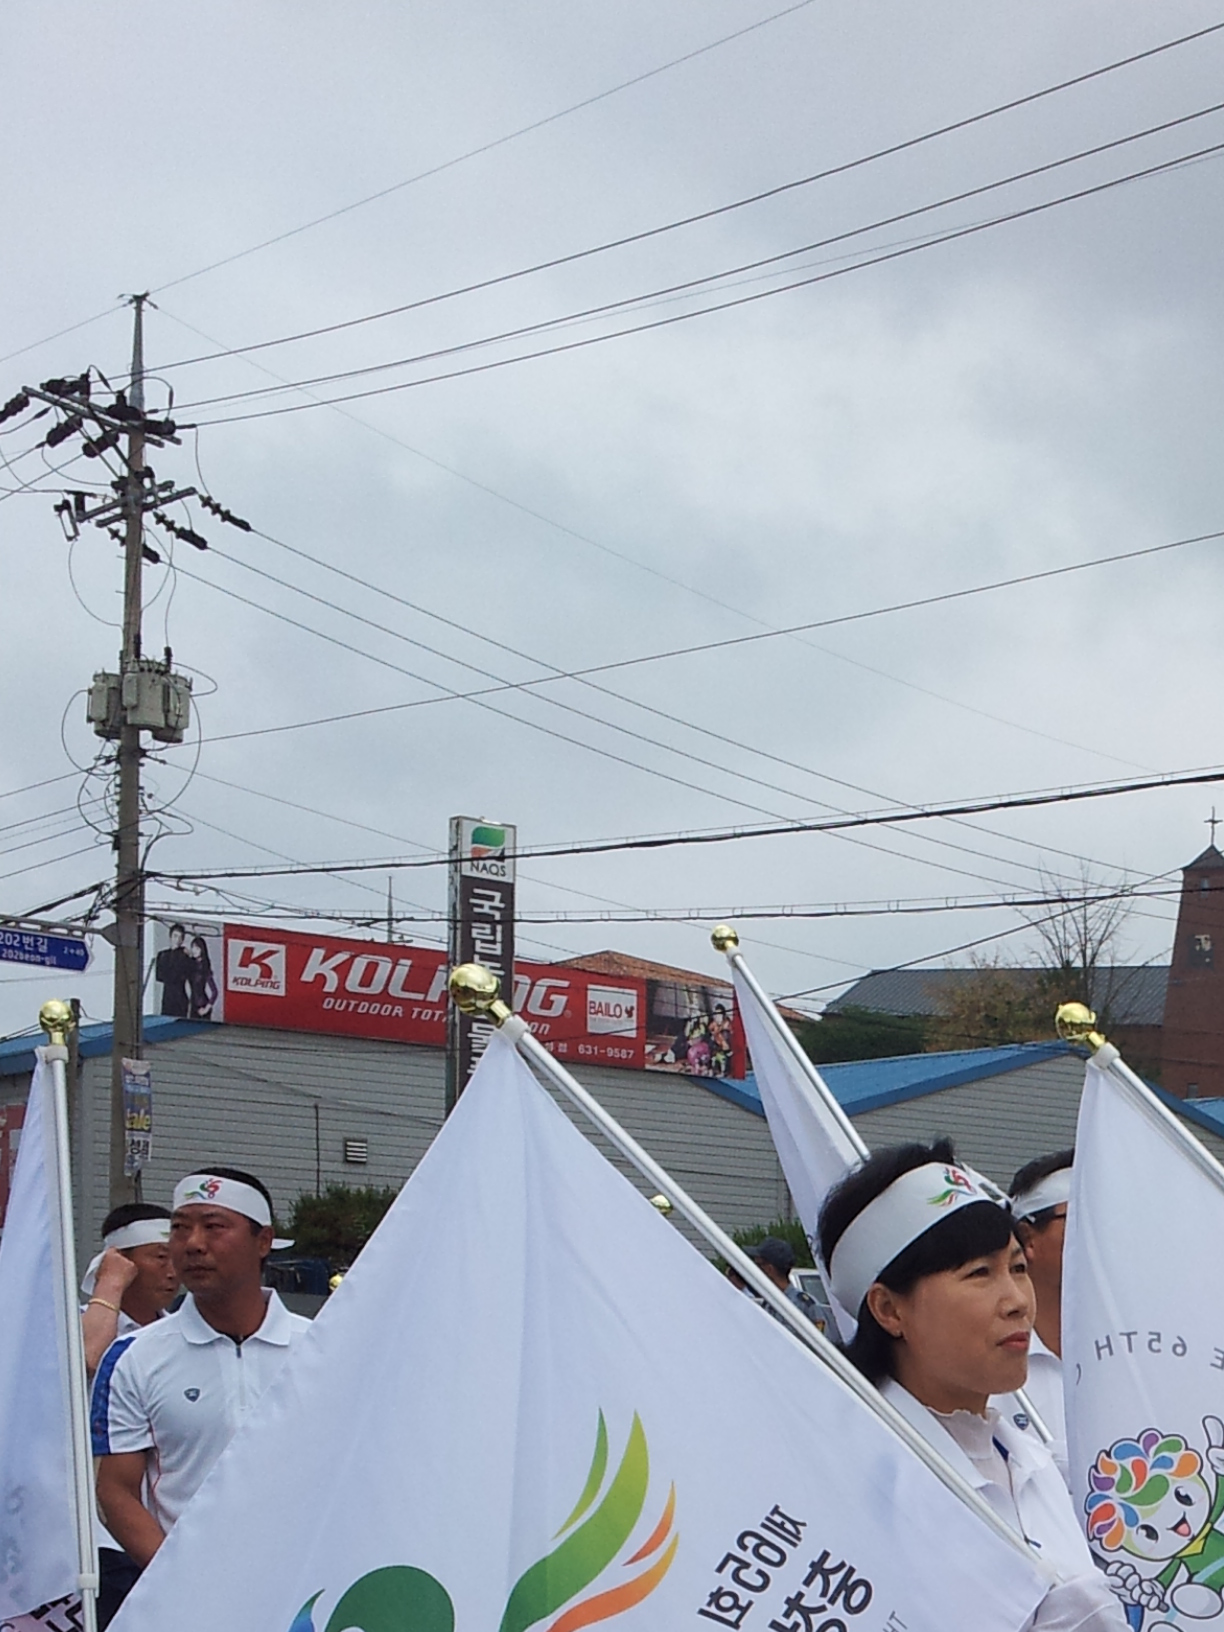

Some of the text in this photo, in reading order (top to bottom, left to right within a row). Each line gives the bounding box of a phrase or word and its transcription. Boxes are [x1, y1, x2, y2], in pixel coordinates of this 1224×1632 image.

[470, 860, 506, 877] NAQS
[322, 997, 404, 1018] OUTDOOR
[578, 1043, 634, 1059] 631-9587
